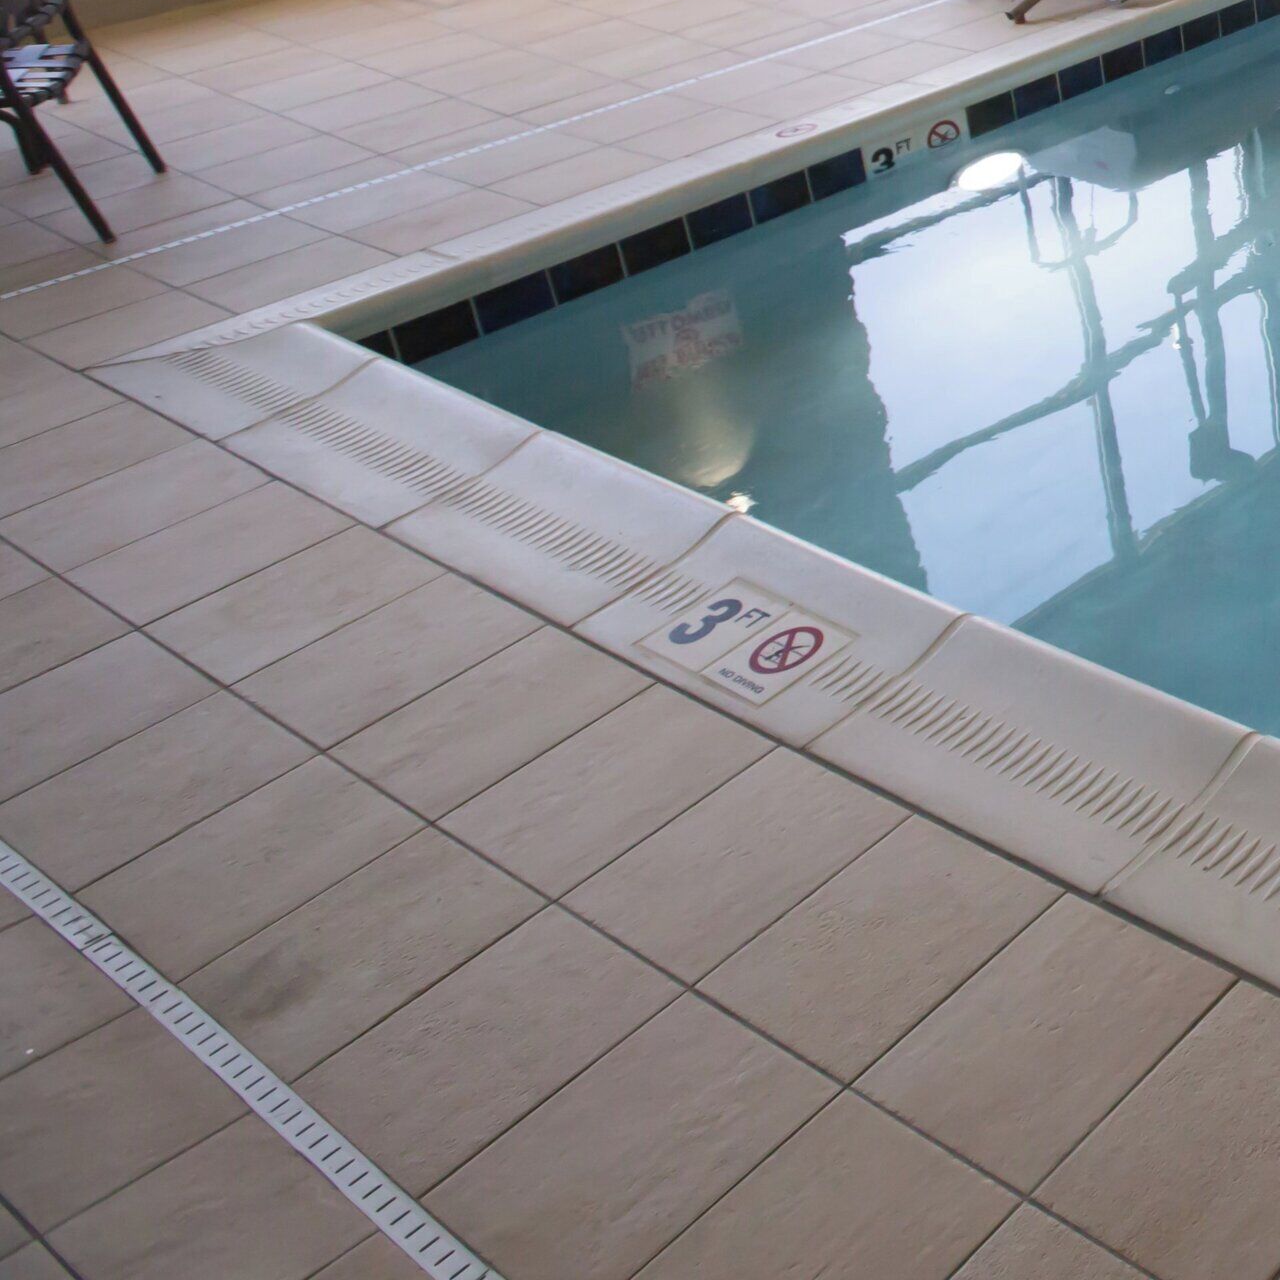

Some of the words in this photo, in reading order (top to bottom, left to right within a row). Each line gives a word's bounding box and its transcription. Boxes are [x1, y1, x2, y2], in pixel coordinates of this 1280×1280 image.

[871, 147, 896, 174] 3
[896, 137, 911, 154] FT
[668, 598, 743, 645] 3
[734, 608, 771, 628] FT
[718, 667, 735, 680] NO
[734, 674, 765, 694] DIVING
